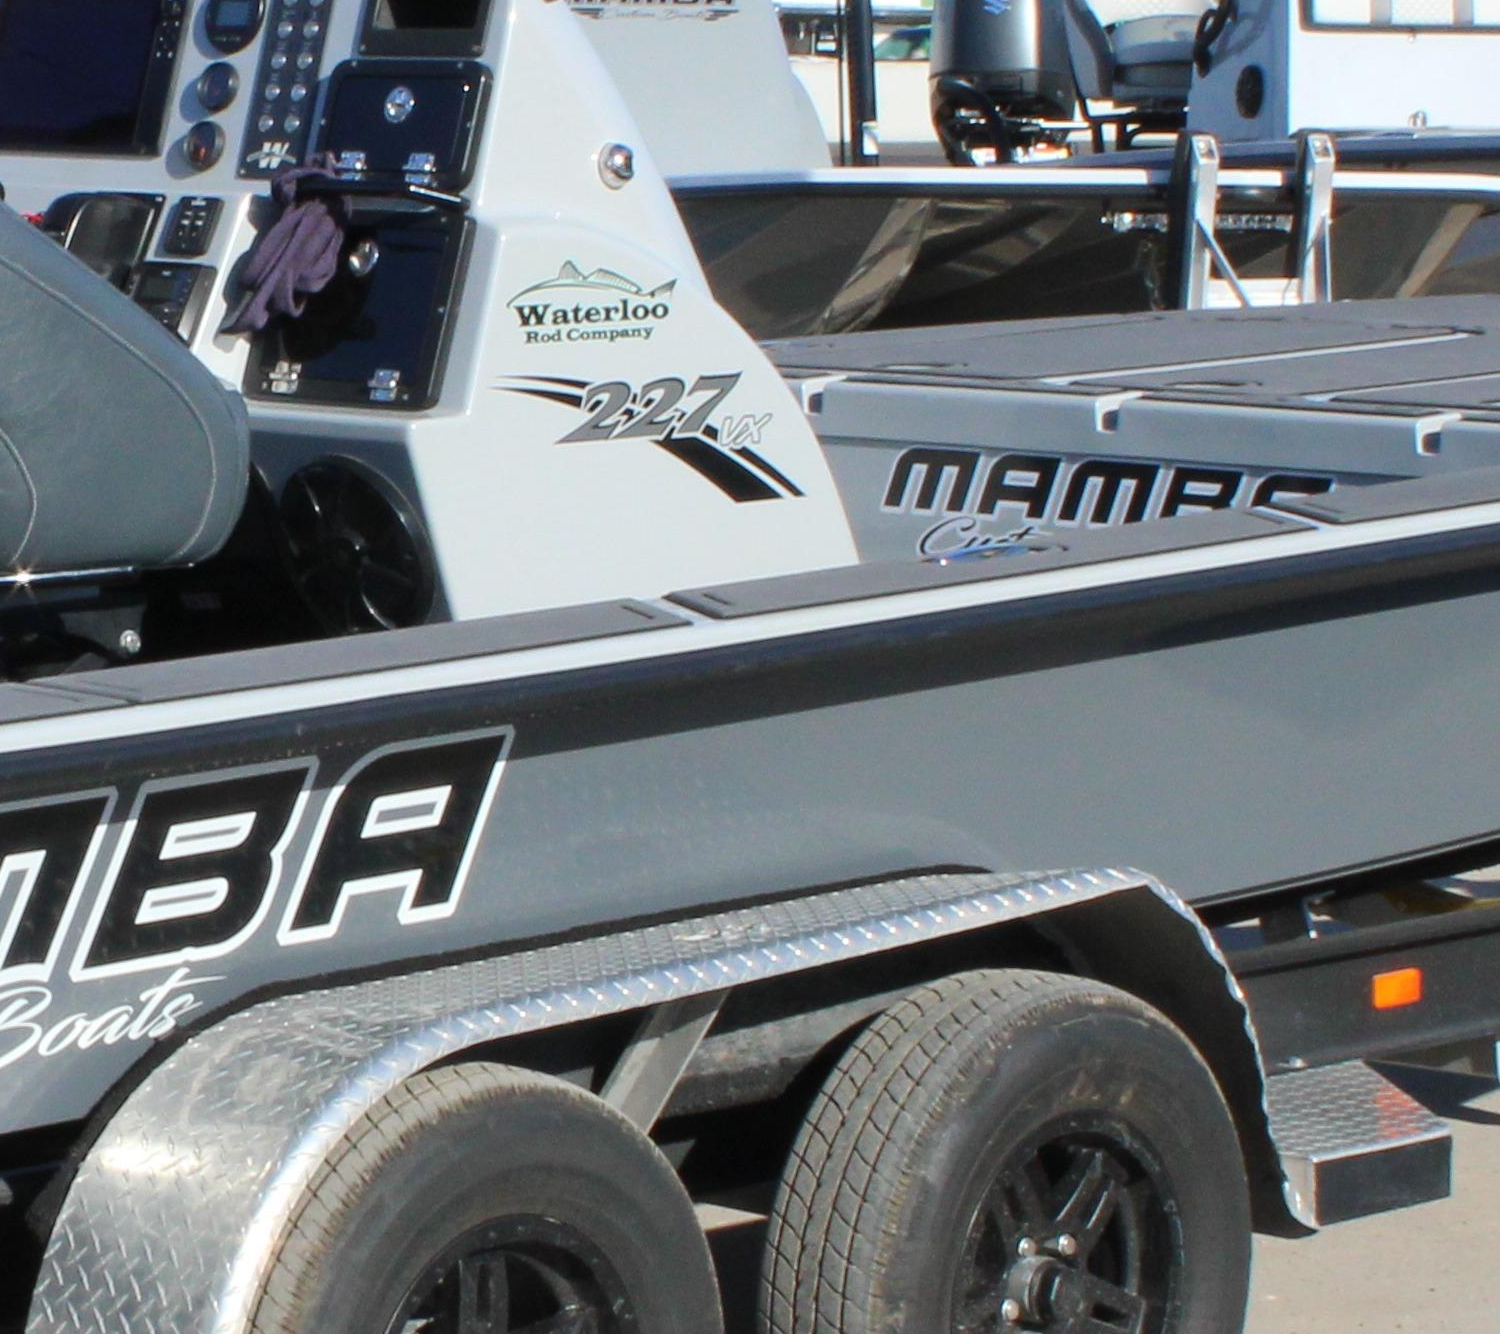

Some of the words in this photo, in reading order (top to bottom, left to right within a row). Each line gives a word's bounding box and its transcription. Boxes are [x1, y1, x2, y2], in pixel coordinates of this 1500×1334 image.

[514, 298, 670, 328] Waterloo
[525, 330, 562, 344] Rod
[566, 327, 655, 343] Company
[553, 370, 743, 445] 227
[719, 413, 773, 447] VX
